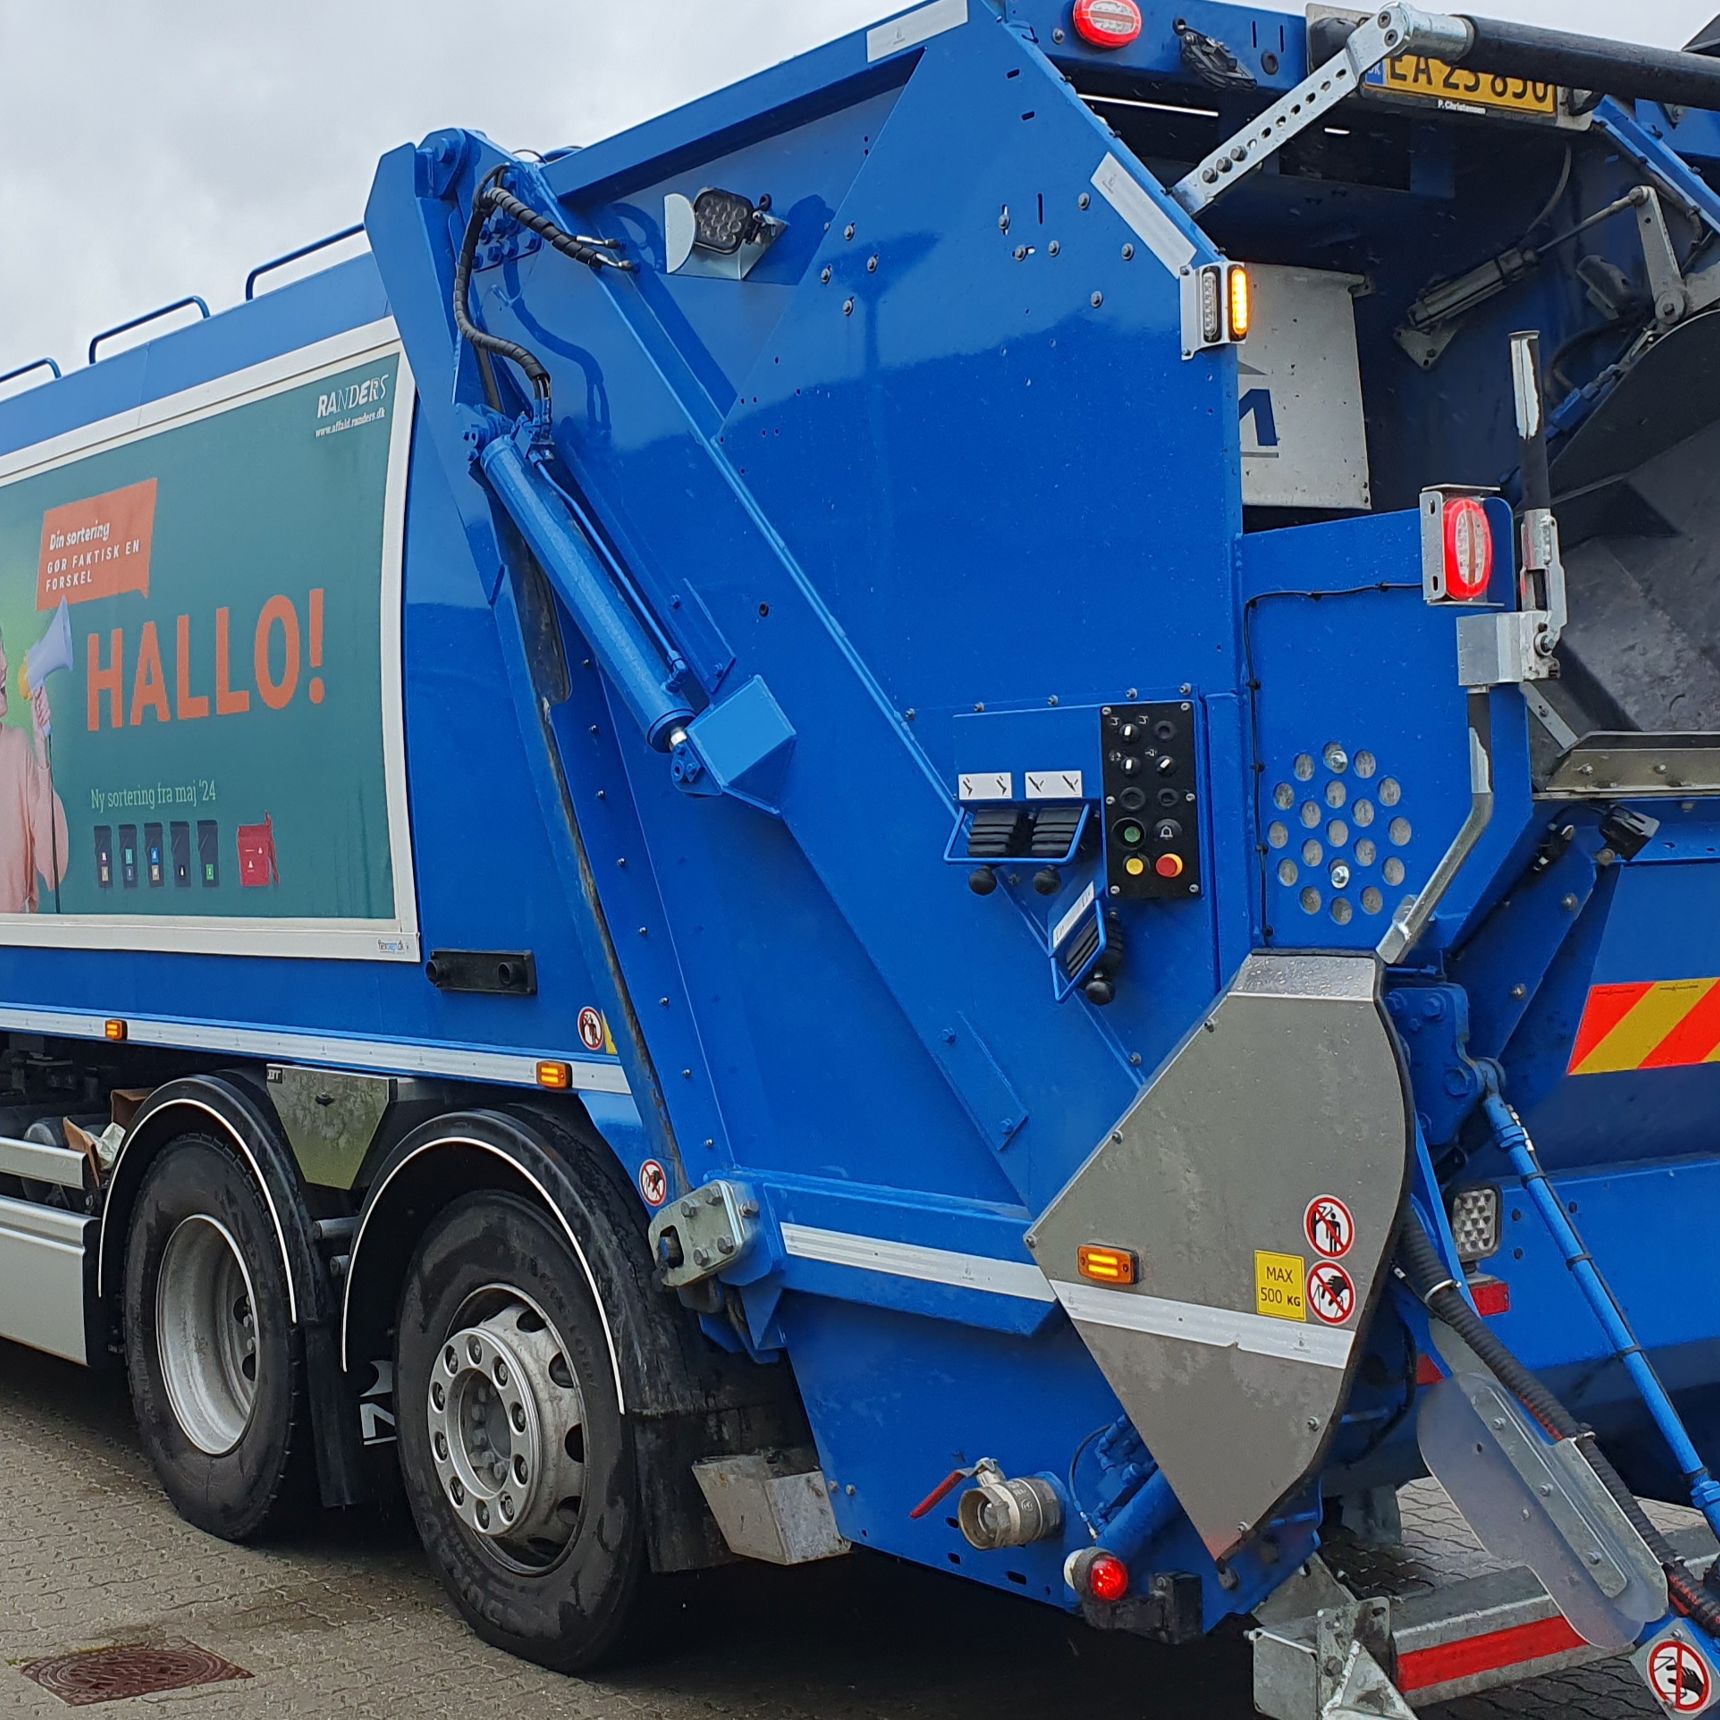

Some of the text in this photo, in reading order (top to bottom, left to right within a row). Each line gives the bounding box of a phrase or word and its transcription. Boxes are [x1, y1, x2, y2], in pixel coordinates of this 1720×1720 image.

[317, 374, 389, 418] RANDERS
[49, 519, 110, 551] Din sortering
[47, 538, 140, 575] GØR FAKTISK EN
[45, 569, 92, 593] FORSKEL
[87, 587, 325, 732] HALLO!
[91, 788, 106, 813] Ny
[108, 784, 155, 810] sortering
[157, 781, 173, 804] fra
[175, 779, 197, 807] maj
[1266, 1265, 1294, 1284] MAX
[1260, 1286, 1301, 1307] 500 KG
